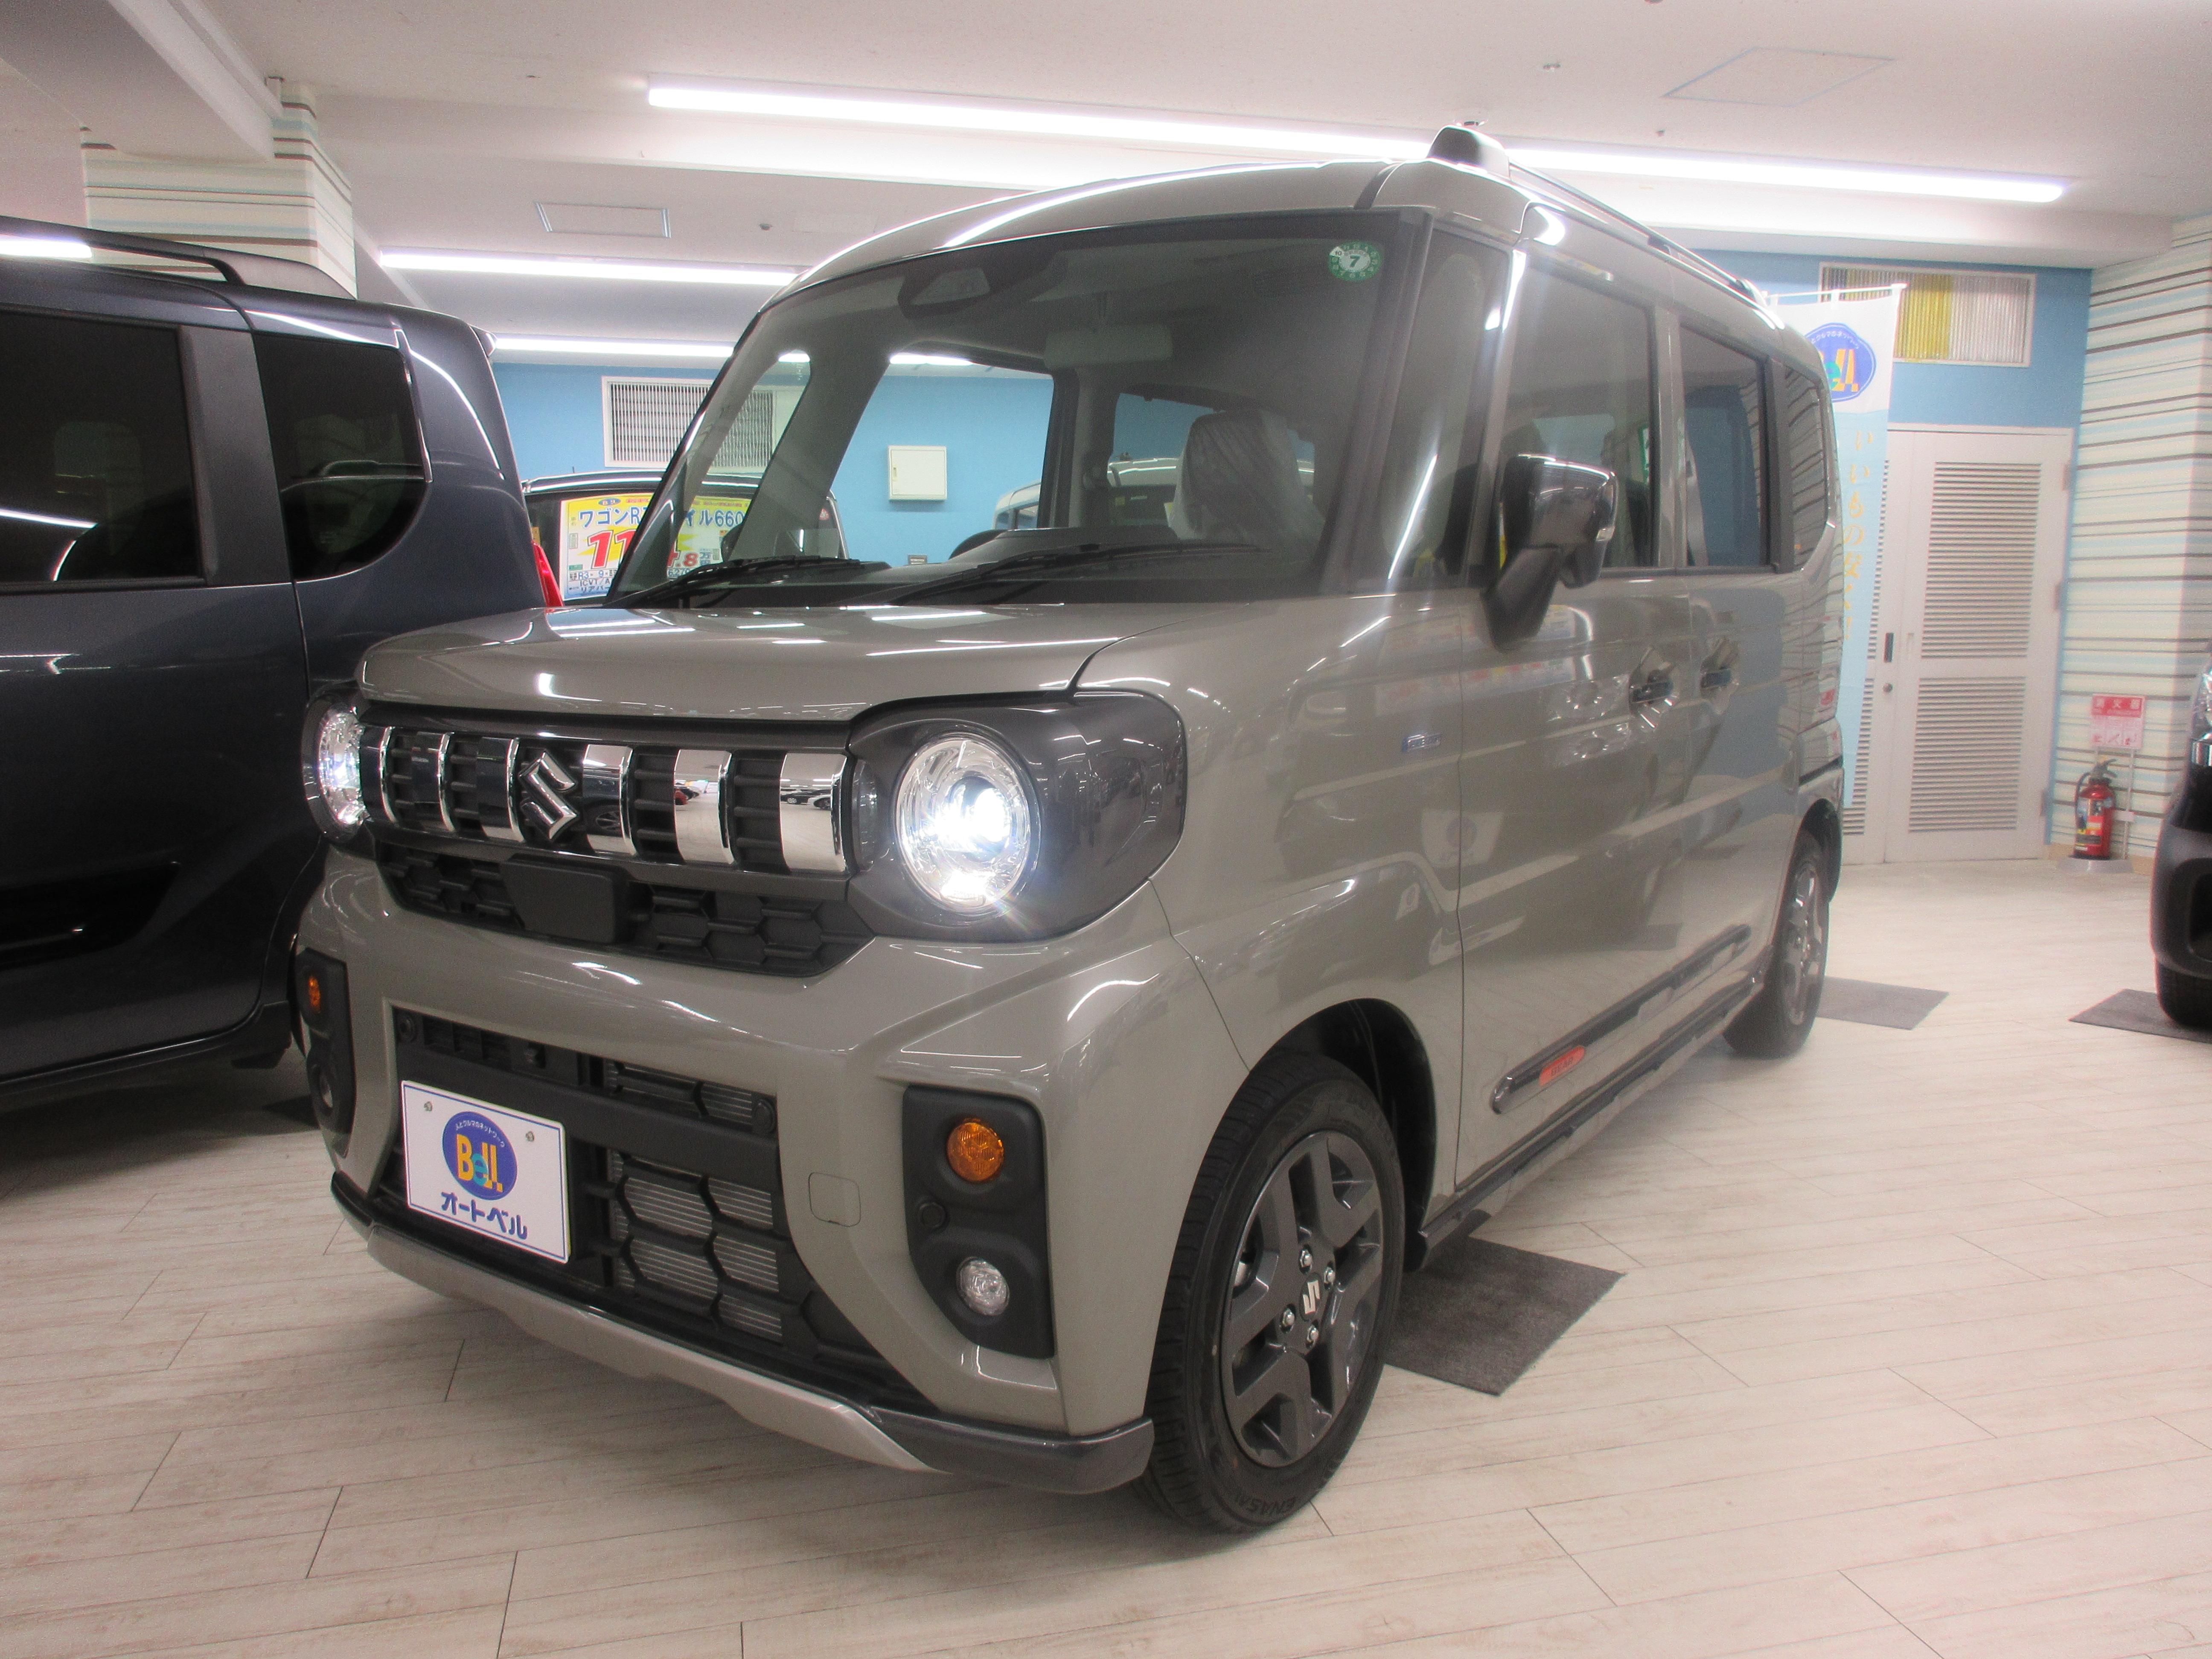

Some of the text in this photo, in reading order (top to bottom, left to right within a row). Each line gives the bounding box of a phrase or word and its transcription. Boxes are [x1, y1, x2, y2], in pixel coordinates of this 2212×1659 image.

[1350, 255, 1360, 268] 7
[1819, 348, 1859, 392] ell
[441, 1192, 528, 1240] オートベル
